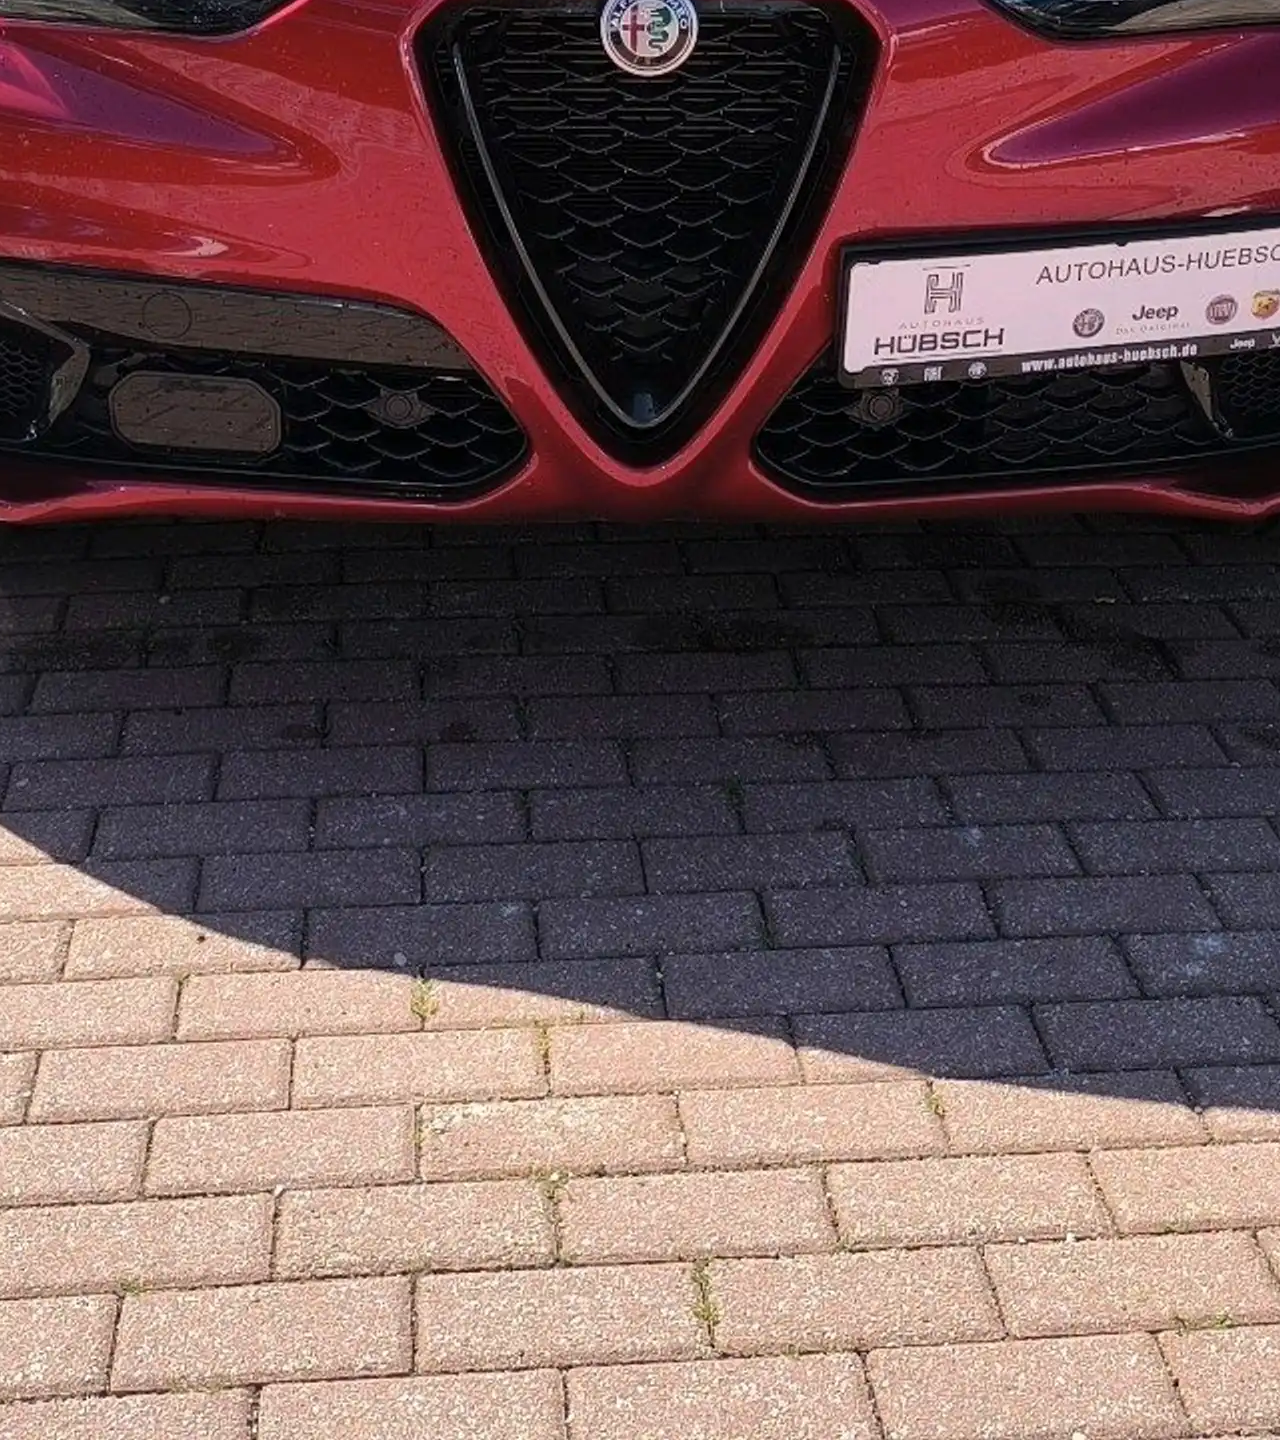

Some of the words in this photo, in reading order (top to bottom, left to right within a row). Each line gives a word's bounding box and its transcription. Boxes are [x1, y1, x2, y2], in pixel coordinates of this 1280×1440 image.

[898, 317, 985, 330] AUTOHAUS
[1132, 304, 1179, 321] Jeep
[874, 328, 1005, 355] HÜBSCH
[1021, 343, 1198, 373] www.autohaus-huebsch.de
